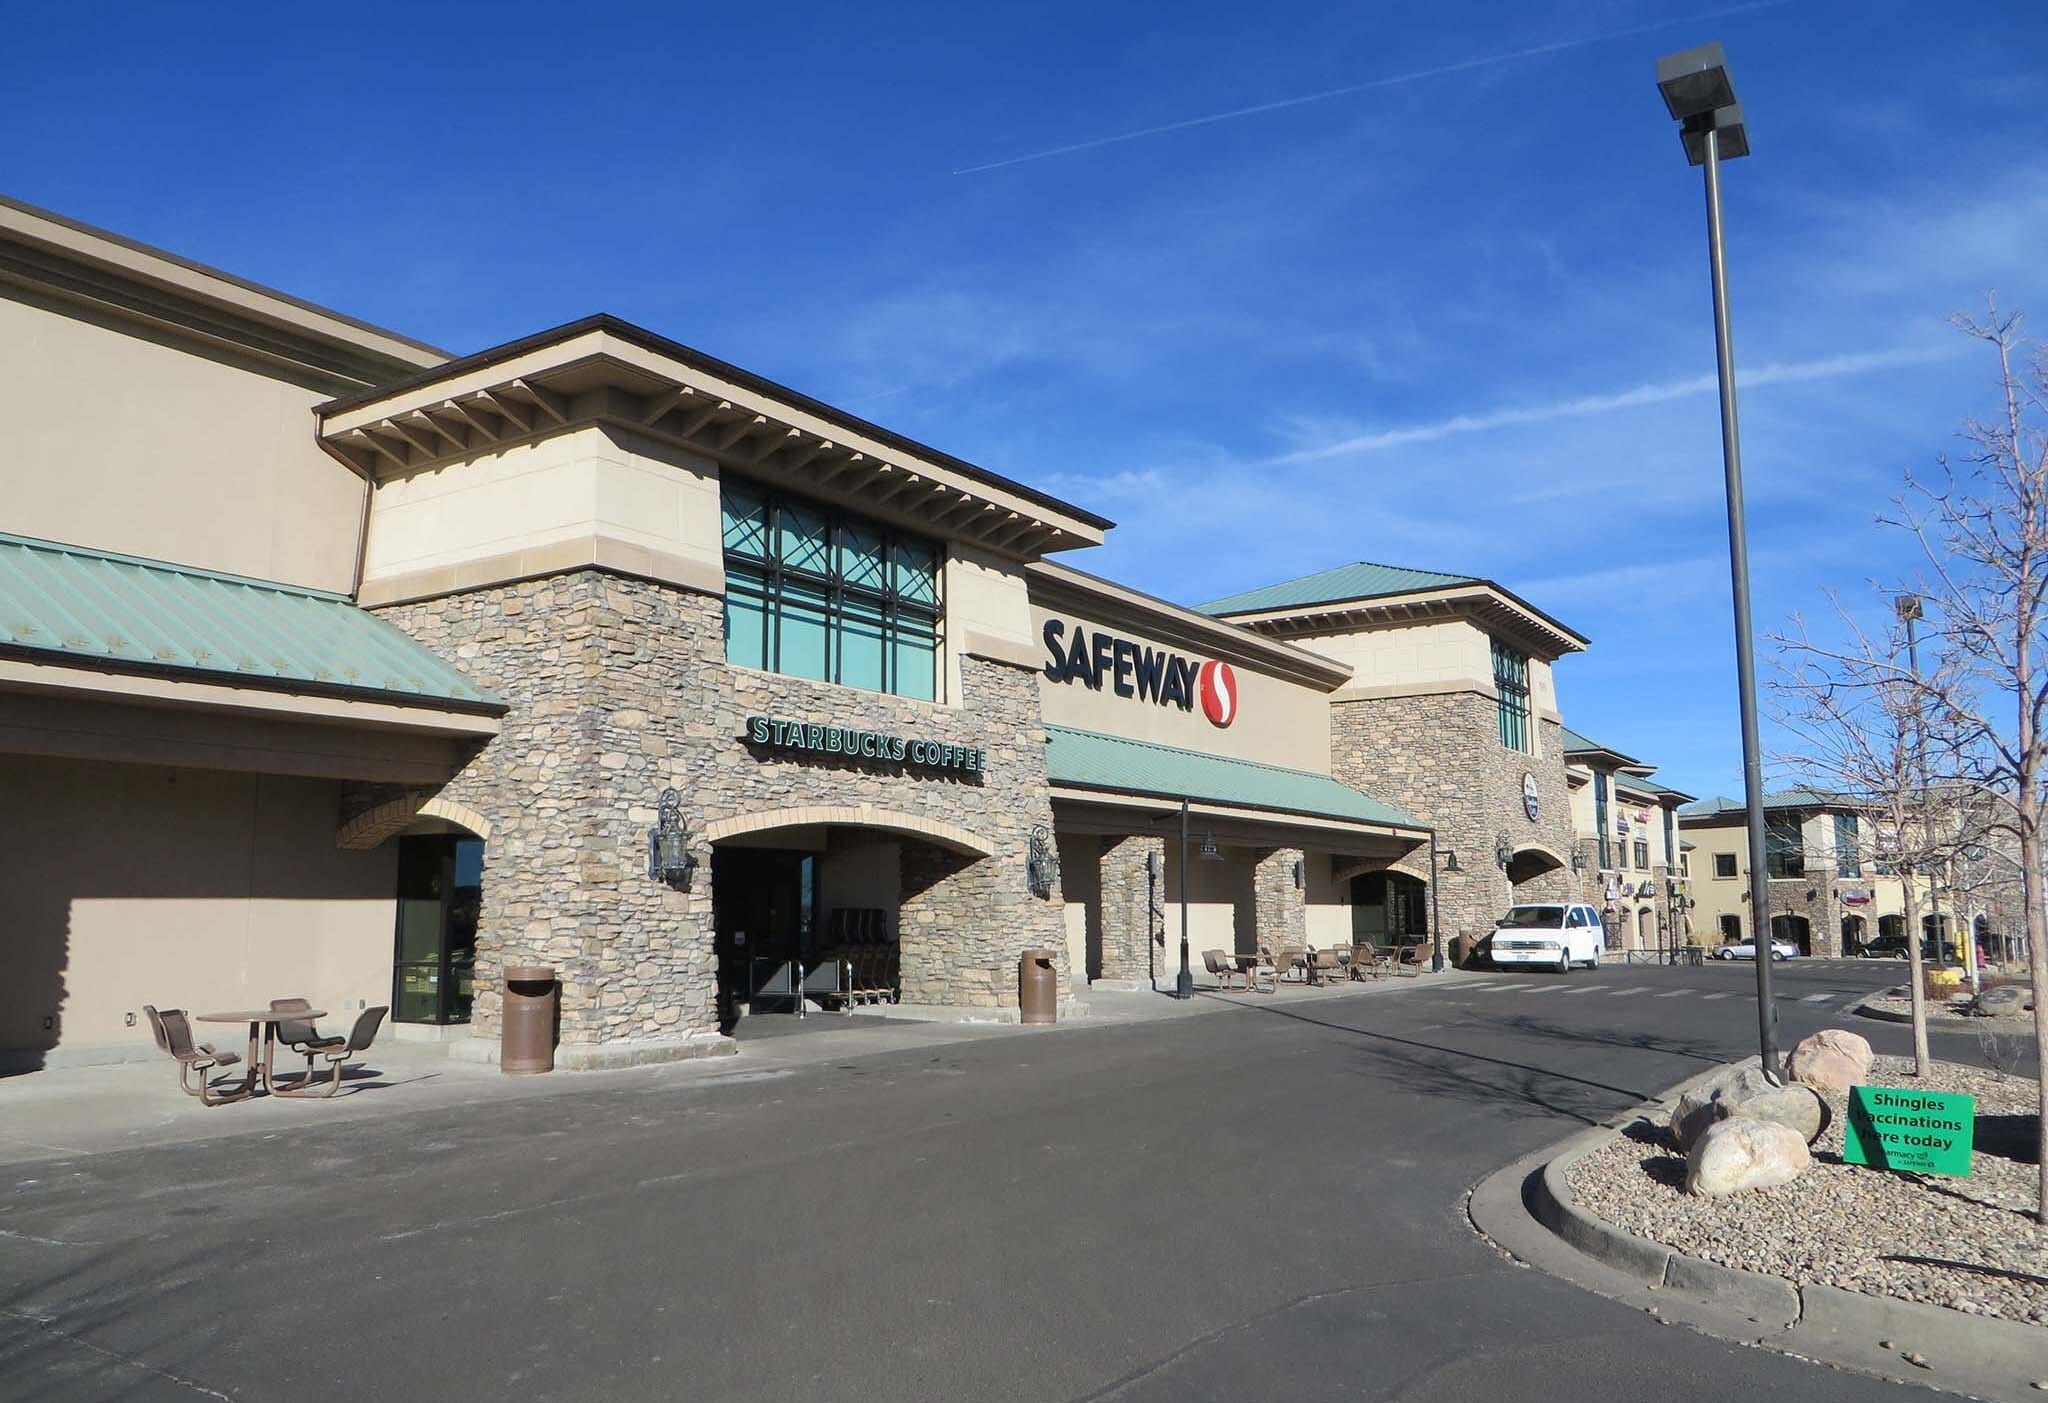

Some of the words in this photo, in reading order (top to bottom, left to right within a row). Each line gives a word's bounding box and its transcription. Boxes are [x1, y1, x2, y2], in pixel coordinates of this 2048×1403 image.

[1043, 618, 1200, 713] SAFEWAY
[751, 715, 906, 762] STARBUCKS
[911, 738, 987, 773] COFFEE
[1874, 1093, 1945, 1111] Shingles
[1903, 1132, 1953, 1151] today
